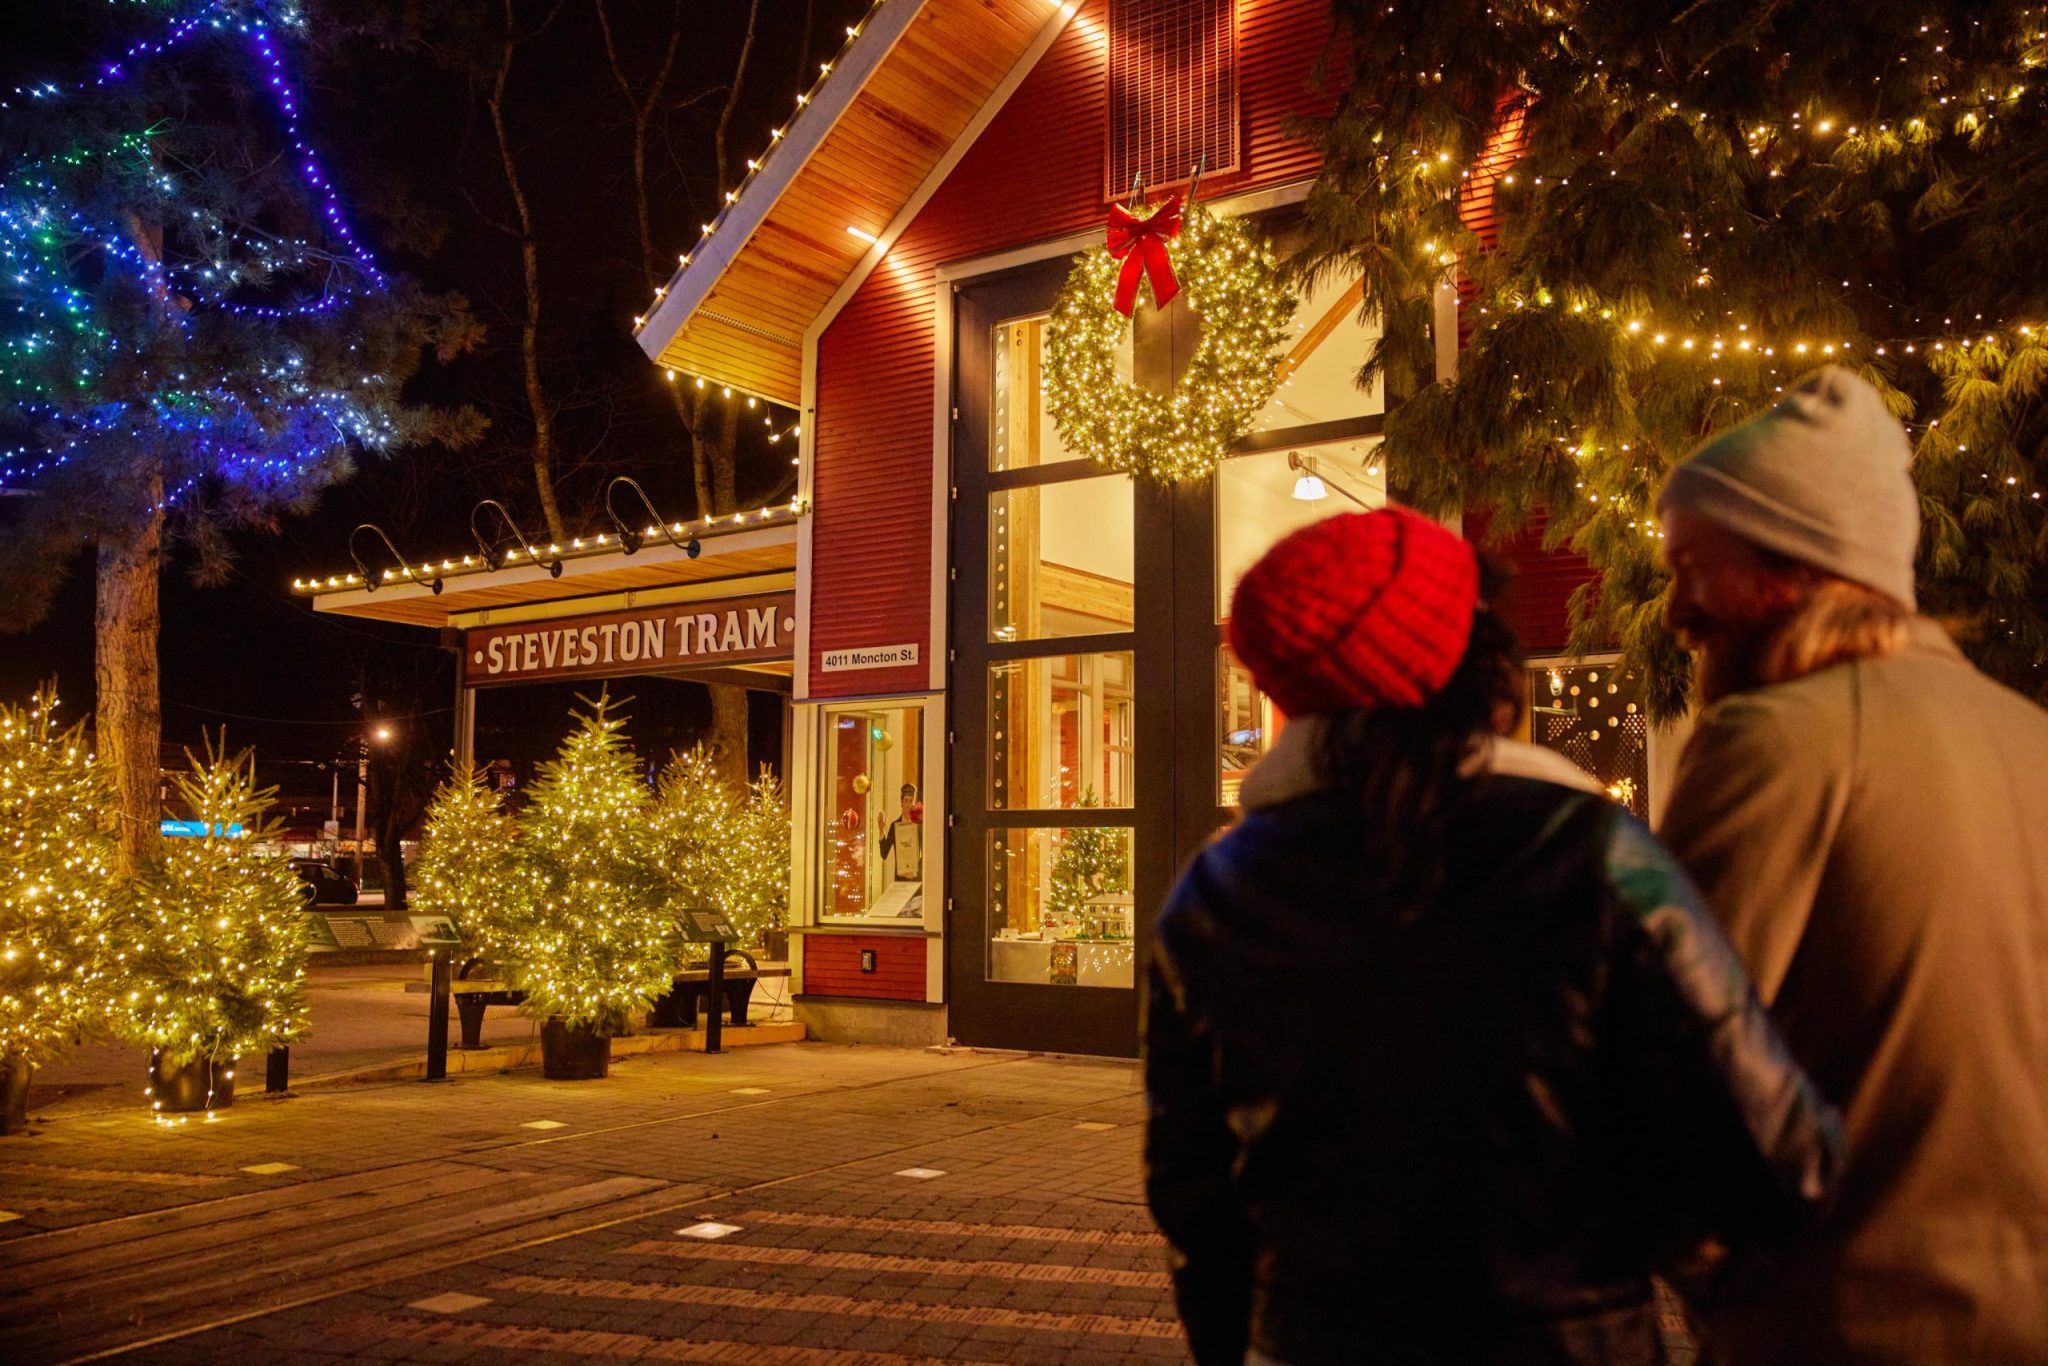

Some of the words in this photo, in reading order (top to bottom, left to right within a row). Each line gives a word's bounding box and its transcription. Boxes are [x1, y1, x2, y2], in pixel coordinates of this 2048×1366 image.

[487, 619, 665, 674] STEVESTON
[674, 606, 778, 656] TRAM
[826, 654, 848, 667] 4011
[851, 653, 897, 665] Moncton
[900, 649, 915, 661] St.
